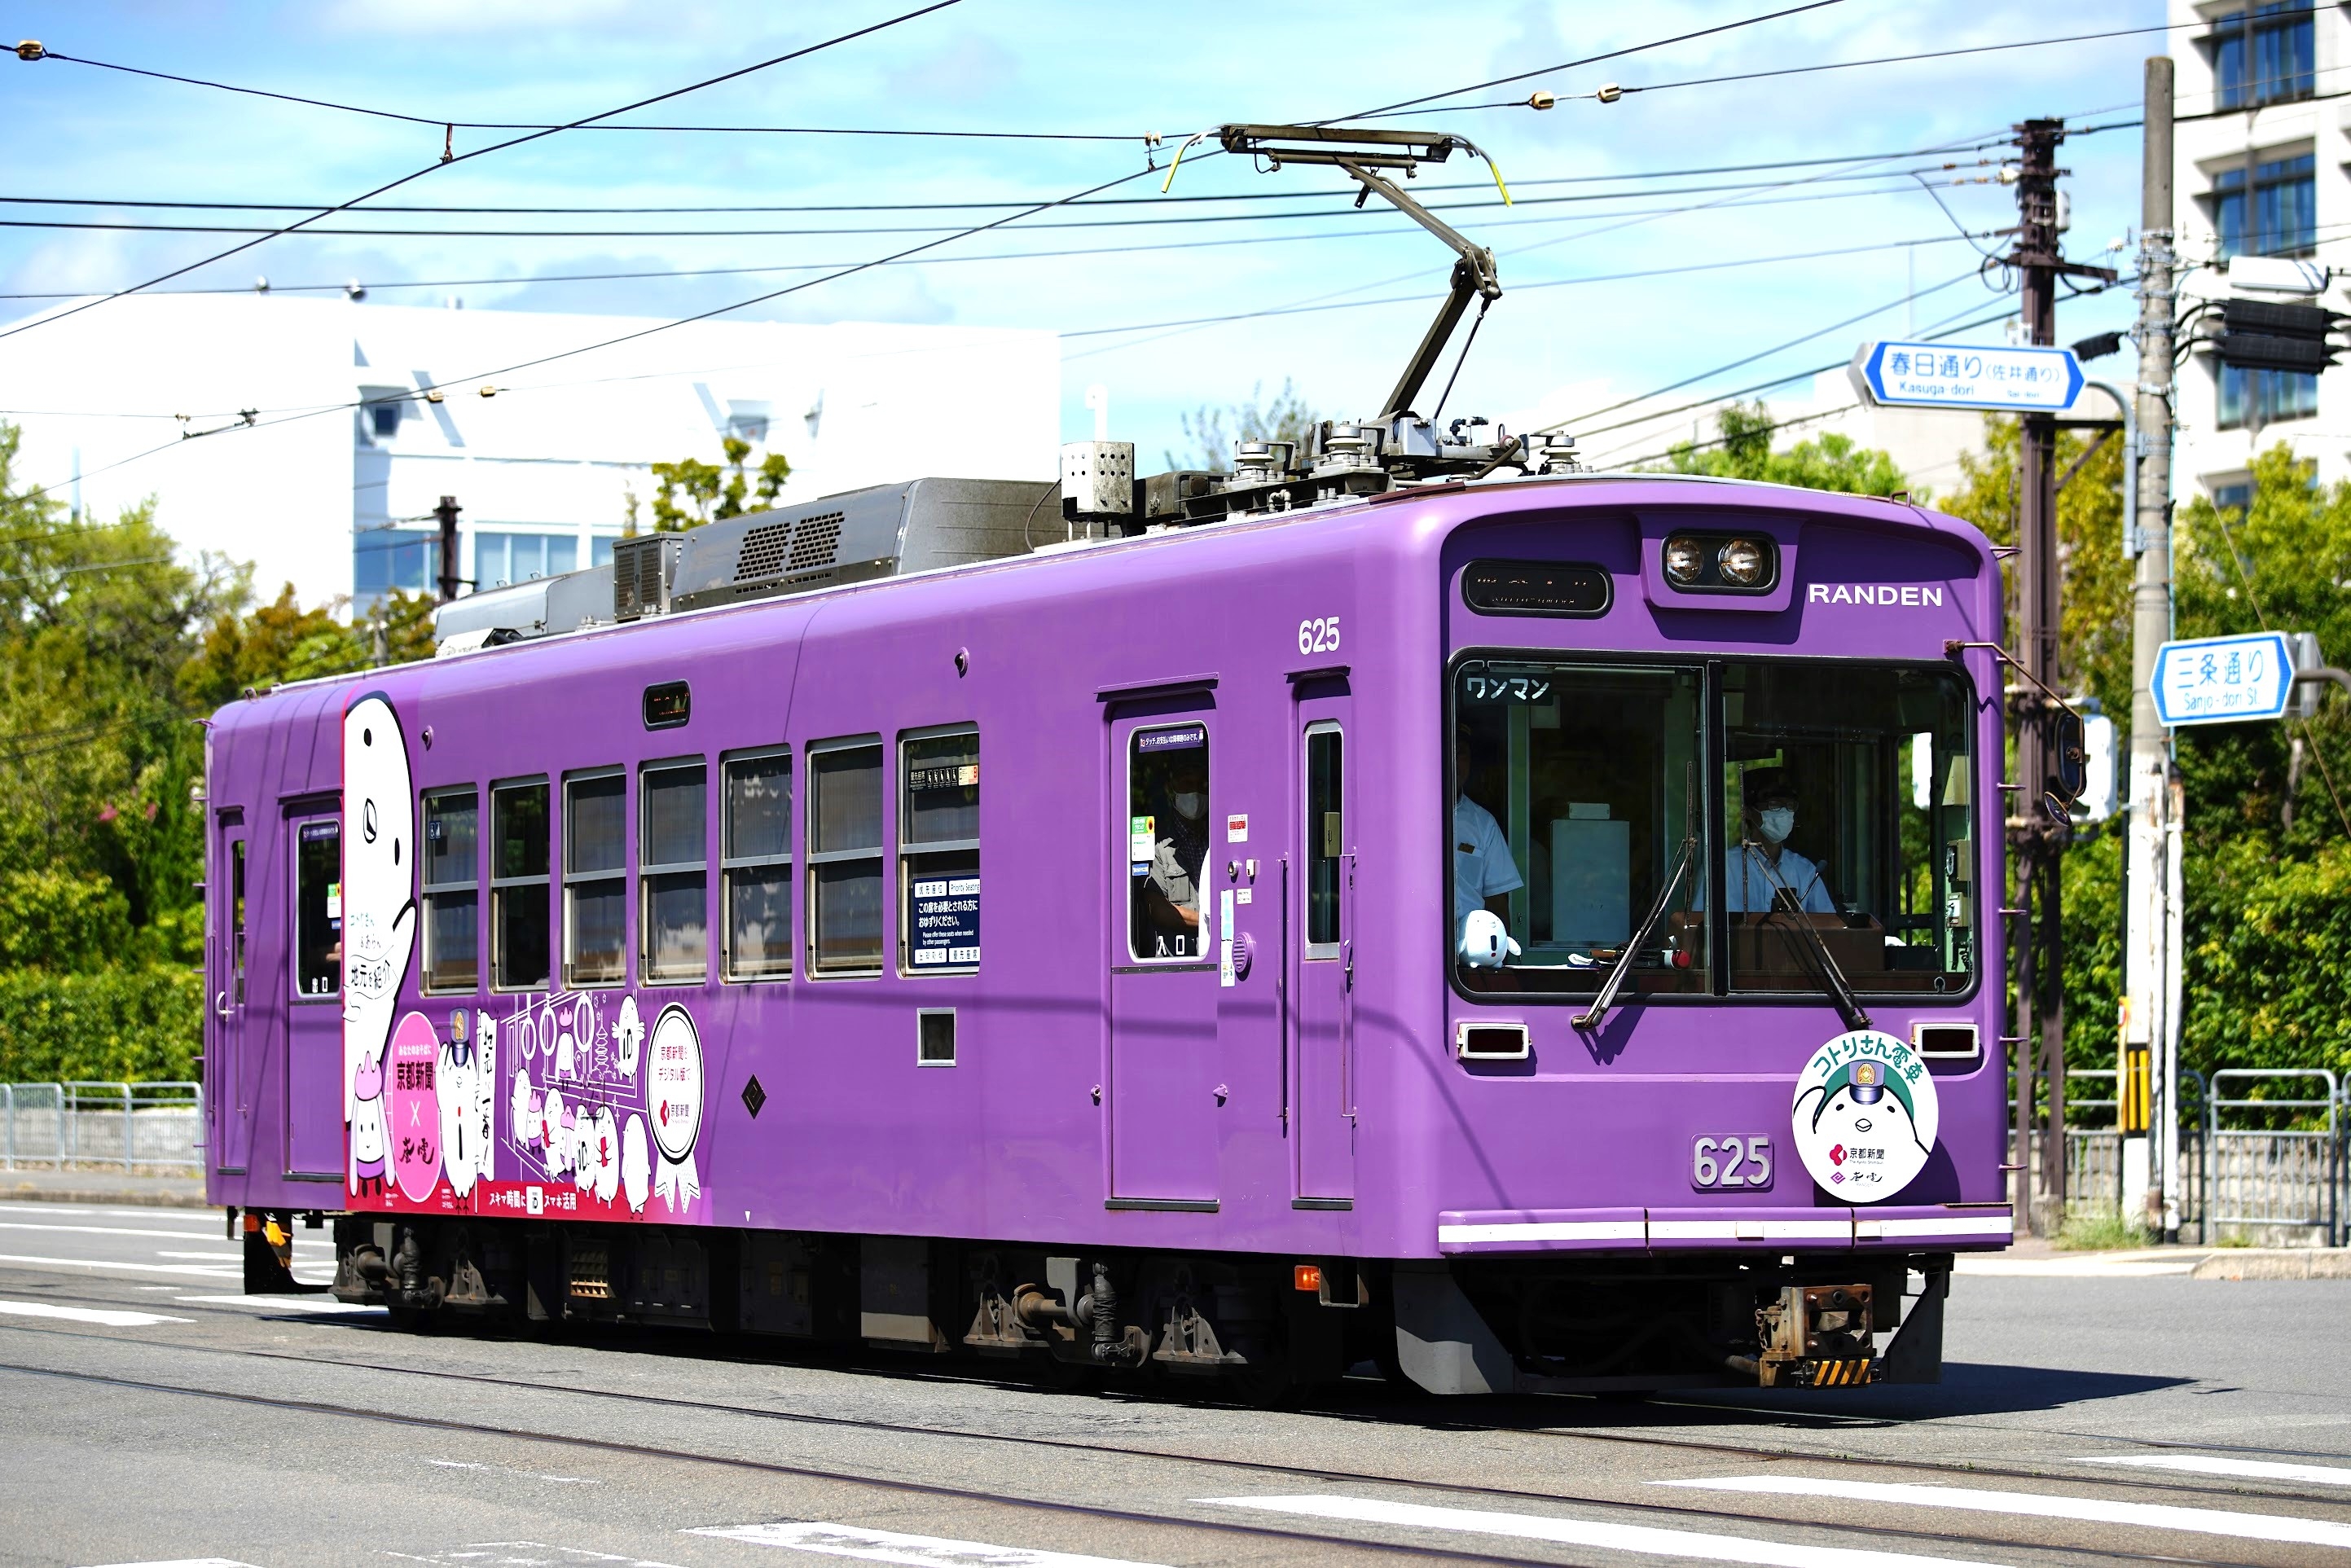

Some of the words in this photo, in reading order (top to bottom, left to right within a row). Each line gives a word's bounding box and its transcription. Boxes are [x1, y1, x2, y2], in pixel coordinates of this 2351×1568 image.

[1890, 352, 1982, 379] 春日通り
[1899, 381, 1974, 397] Kasuga-dori
[1808, 583, 1942, 607] RANDEN
[1299, 616, 1340, 656] 625
[2177, 649, 2264, 689] 三条通り
[1466, 677, 1549, 701] ワンマン
[951, 884, 965, 893] Priority
[918, 899, 978, 913] この席を必要とされる方に
[918, 915, 960, 928] おゆずりください。
[1157, 934, 1185, 955] 入口
[397, 1061, 434, 1091] 京都新聞
[1694, 1136, 1771, 1186] 625
[1849, 1148, 1885, 1160] 京都新聞
[489, 1190, 526, 1209] スキマ時間に
[544, 1192, 577, 1210] スマホ活用
